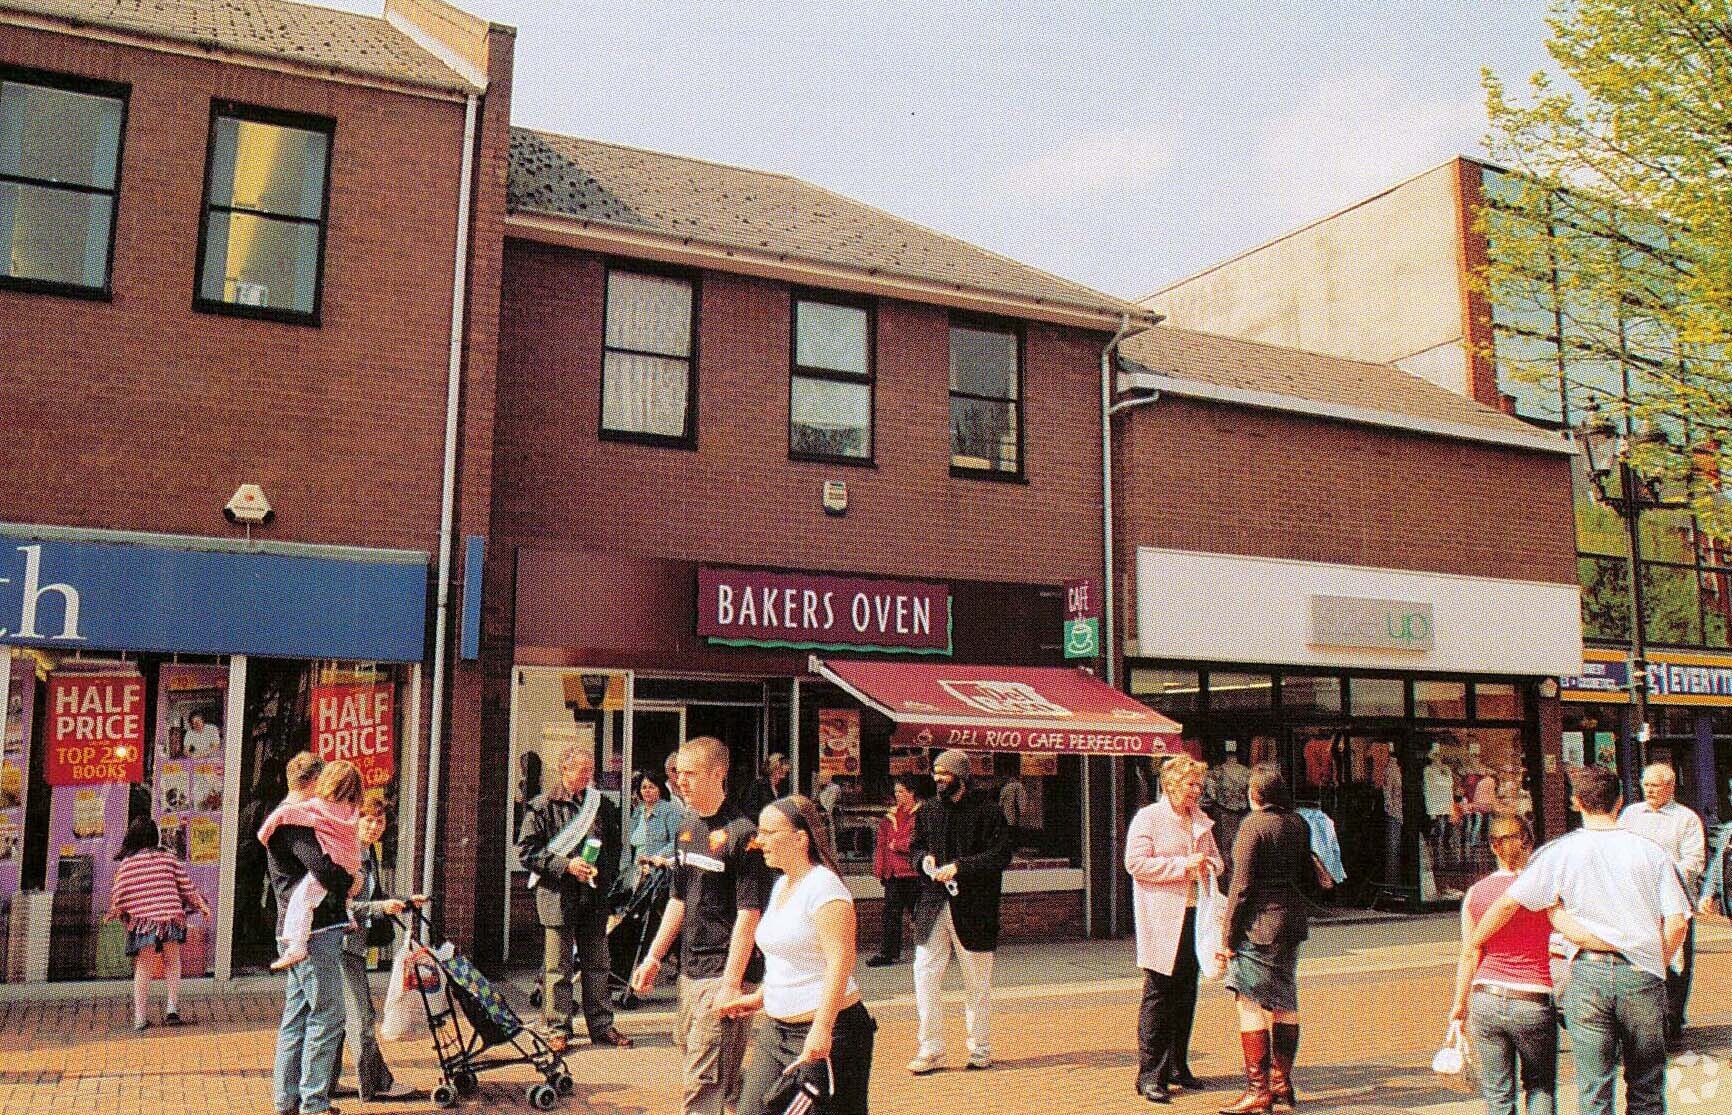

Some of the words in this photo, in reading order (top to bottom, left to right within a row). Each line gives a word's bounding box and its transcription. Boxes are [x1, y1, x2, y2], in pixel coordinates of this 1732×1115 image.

[718, 584, 835, 630] BAKERS
[852, 592, 930, 635] OVEN
[56, 685, 140, 714] HALF
[319, 692, 389, 732] HALF
[56, 714, 140, 740] PRICE
[948, 729, 979, 746] DEL
[985, 730, 1021, 748] RICO
[1027, 732, 1064, 749] CAFE
[1069, 733, 1142, 751] PERFECTO
[56, 747, 96, 764] TOP
[319, 724, 389, 761] PRICE
[72, 764, 126, 779] BOOKS
